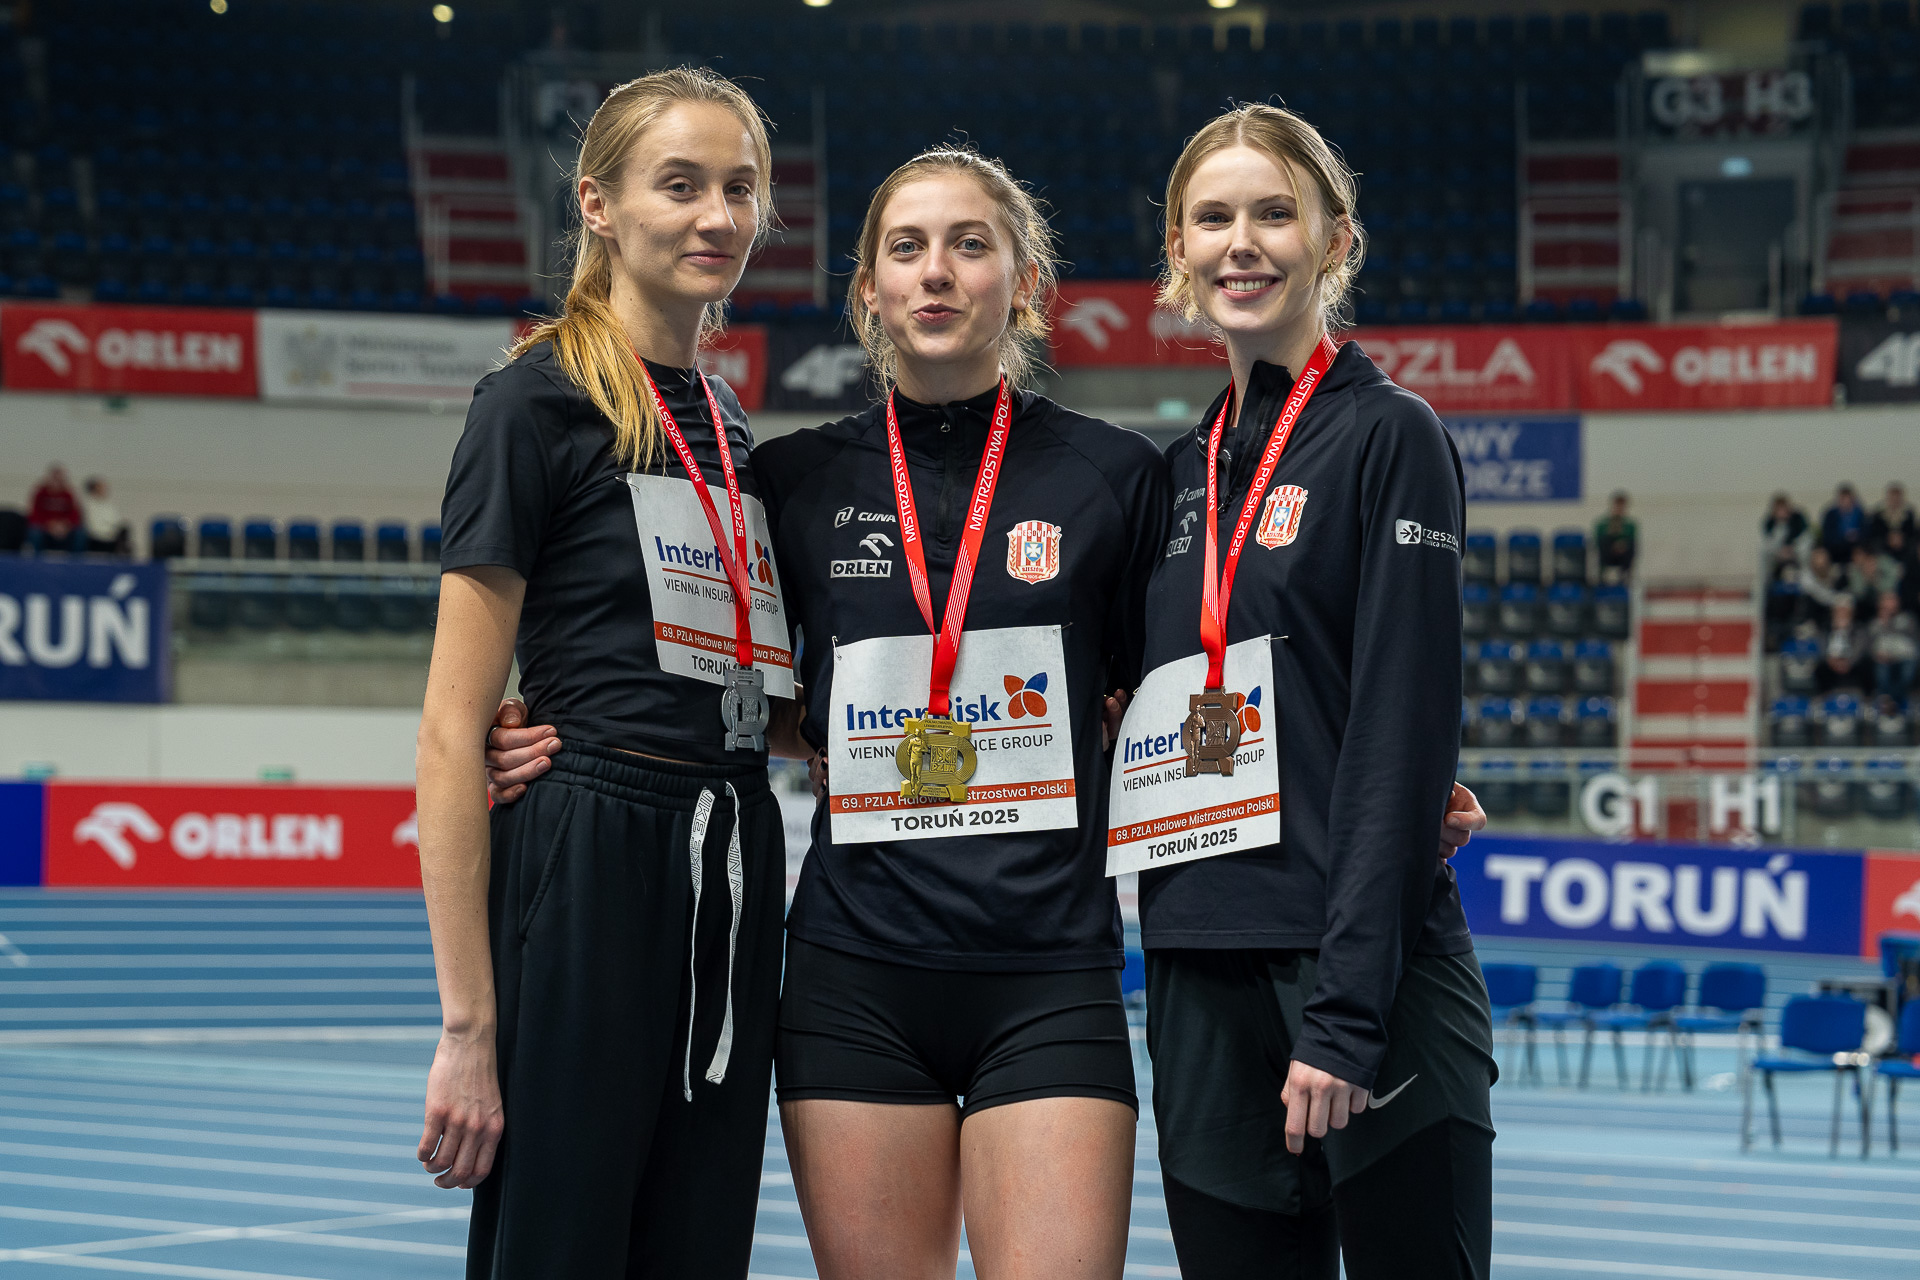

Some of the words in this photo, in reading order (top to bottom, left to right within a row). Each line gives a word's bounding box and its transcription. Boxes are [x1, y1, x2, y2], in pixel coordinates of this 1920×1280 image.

[95, 327, 243, 373] ORLEN
[1671, 345, 1818, 386] ORLEN
[1263, 367, 1320, 465] MISTRZOSTWA
[722, 449, 739, 500] POLSKI
[733, 504, 744, 538] 2025
[892, 442, 917, 543] MISTRZOSTWA
[969, 430, 1005, 531] MISTRZOSTWA
[1242, 467, 1271, 518] POLSKI
[857, 511, 897, 523] CUNA
[1017, 529, 1052, 538] RESOVIA
[655, 535, 755, 581] Interk
[1230, 521, 1249, 557] 2025
[832, 561, 889, 575] ORLEN
[663, 577, 700, 597] VIENNA
[702, 585, 752, 609] INSURA
[754, 597, 779, 616] GROUP
[662, 626, 676, 639] 69.
[676, 629, 694, 644] PZLA
[694, 633, 722, 650] Halowe
[723, 640, 768, 660] Mistwa
[769, 649, 790, 664] Polski
[846, 694, 1002, 731] Interisk
[848, 745, 896, 760] VIENN
[1002, 733, 1054, 750] GROUP
[841, 796, 862, 809] 69.
[864, 794, 894, 808] PZLA
[966, 785, 1027, 802] strzostwa
[1029, 782, 1068, 796] Polski
[1123, 770, 1162, 792] VIENNA
[890, 808, 964, 832] TORUŃ
[968, 808, 1020, 826] 2025
[1115, 828, 1130, 842] 69.
[1131, 823, 1151, 840] PZLA
[1153, 815, 1187, 834] Halowe
[1188, 803, 1245, 826] Mistrzostwa
[1246, 797, 1275, 815] Polski
[1580, 773, 1657, 837] G1
[1710, 774, 1782, 835] H1
[169, 812, 344, 860] ORLEN
[1147, 831, 1198, 860] TORUŃ
[1200, 827, 1238, 849] 2025
[1484, 853, 1809, 941] TORUŃ
